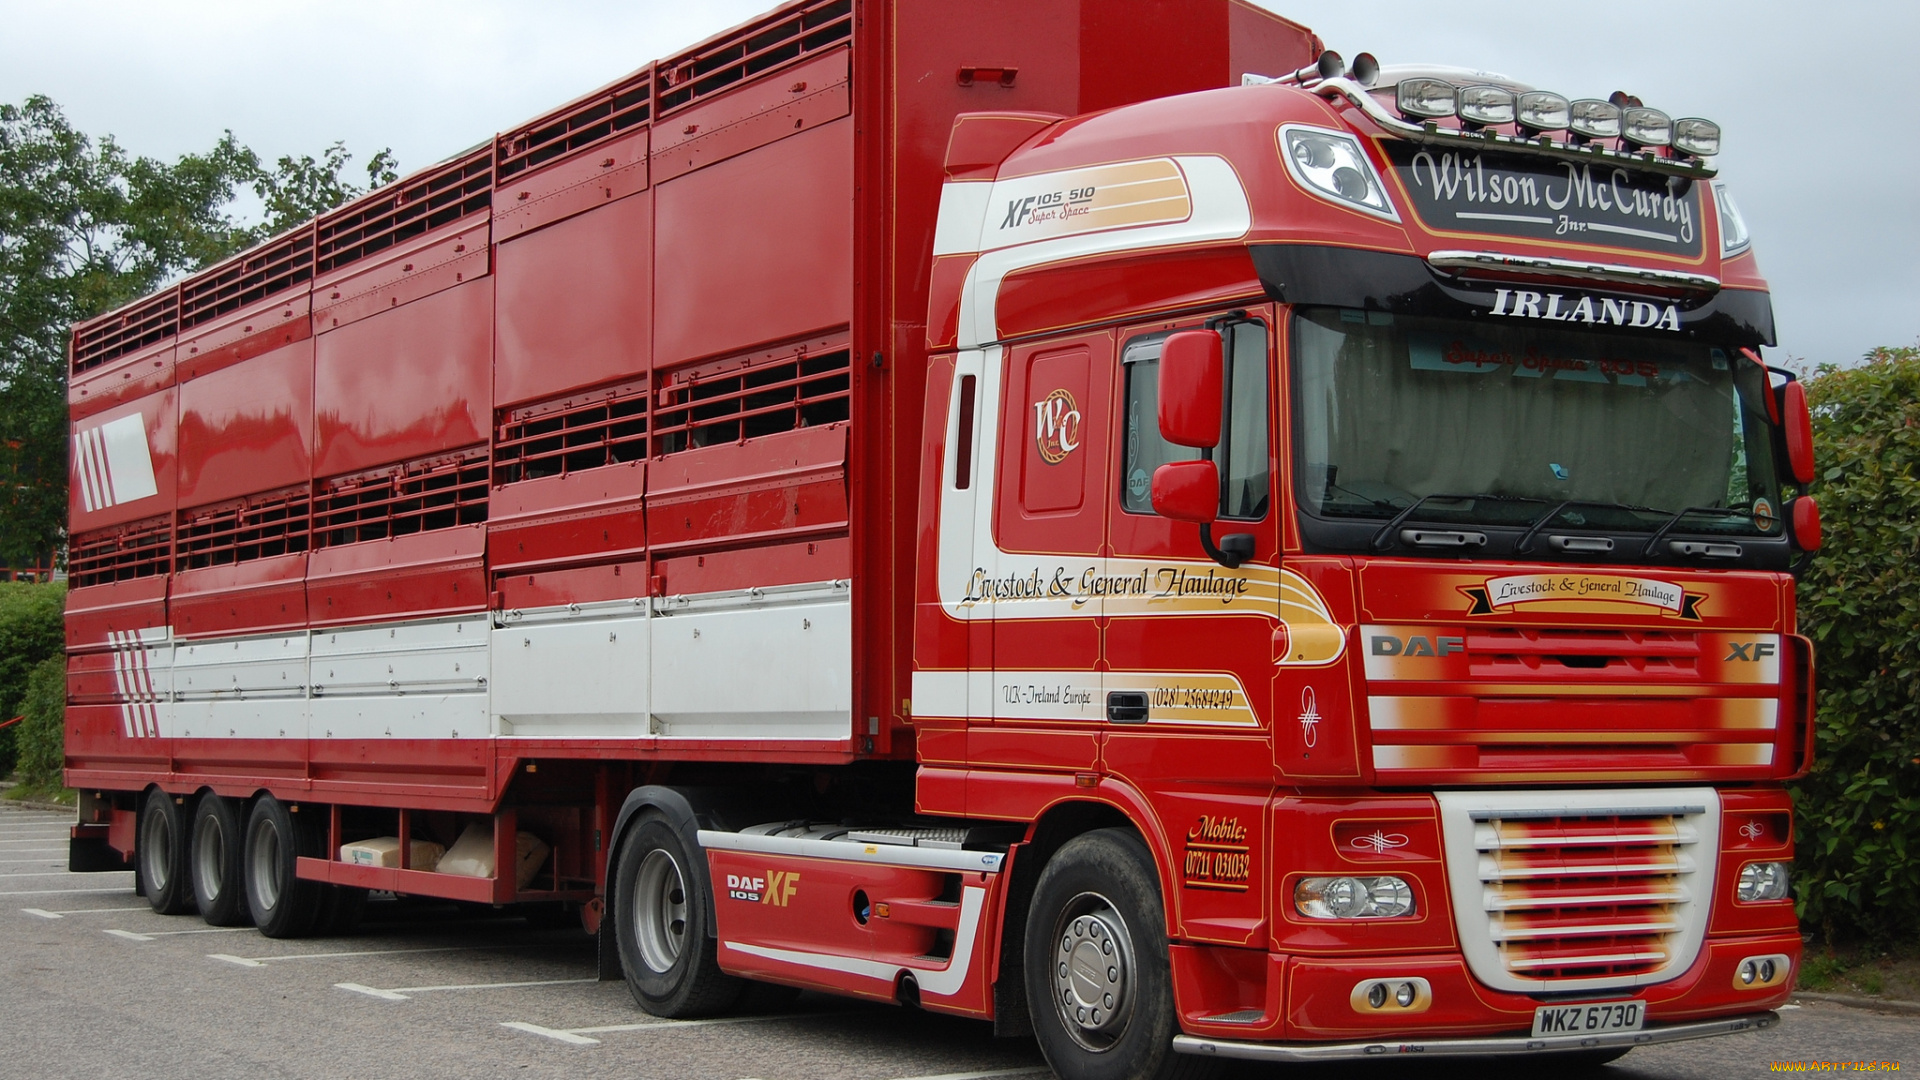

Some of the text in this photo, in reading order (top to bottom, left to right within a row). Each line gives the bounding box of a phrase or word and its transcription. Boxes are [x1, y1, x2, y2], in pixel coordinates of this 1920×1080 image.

[1000, 186, 1096, 230] XF 105 510
[1412, 151, 1693, 244] Wilson McCurdy
[1028, 202, 1090, 225] Super Space
[1489, 288, 1681, 332] IRLANDA
[1446, 340, 1513, 368] Super
[1129, 478, 1149, 488] DAF
[960, 566, 1249, 605] Livestock & General Haulage
[1496, 577, 1676, 603] Livestock & General Haulage
[1371, 634, 1464, 658] DAF
[1723, 641, 1776, 662] XF
[1063, 685, 1092, 712] Europe
[1153, 684, 1180, 709] (028)
[1188, 814, 1248, 840] Mobile:
[1186, 850, 1250, 878] 07711 031032
[727, 869, 801, 907] DAF XF
[729, 890, 760, 902] 105
[1541, 1004, 1638, 1033] WKZ 6730
